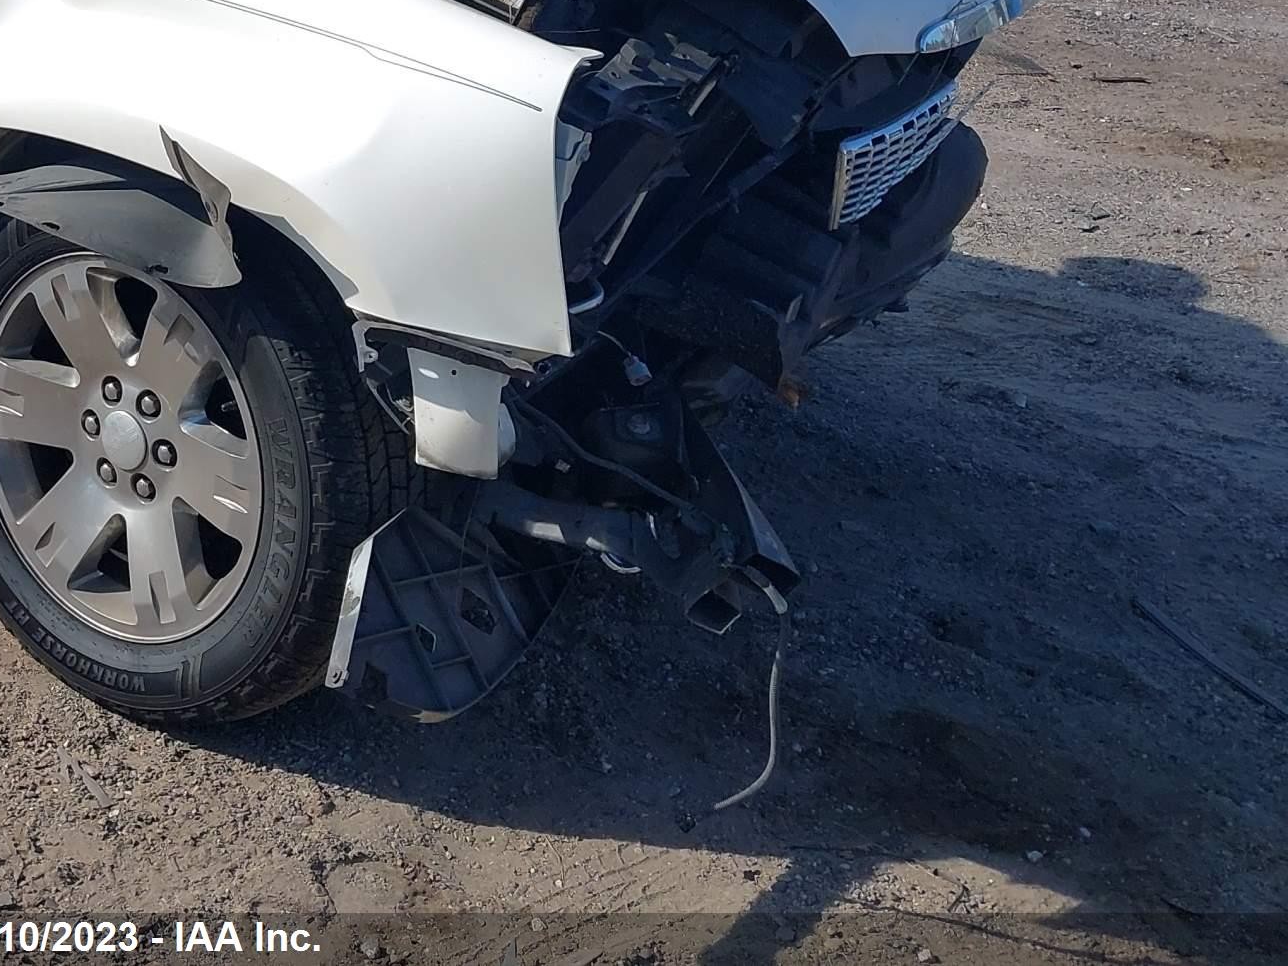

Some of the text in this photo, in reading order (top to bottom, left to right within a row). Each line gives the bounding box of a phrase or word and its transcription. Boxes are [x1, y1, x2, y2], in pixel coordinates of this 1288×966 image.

[244, 416, 298, 649] WRANGLER
[3, 599, 31, 626] HT
[30, 627, 146, 693] WORKHORSE
